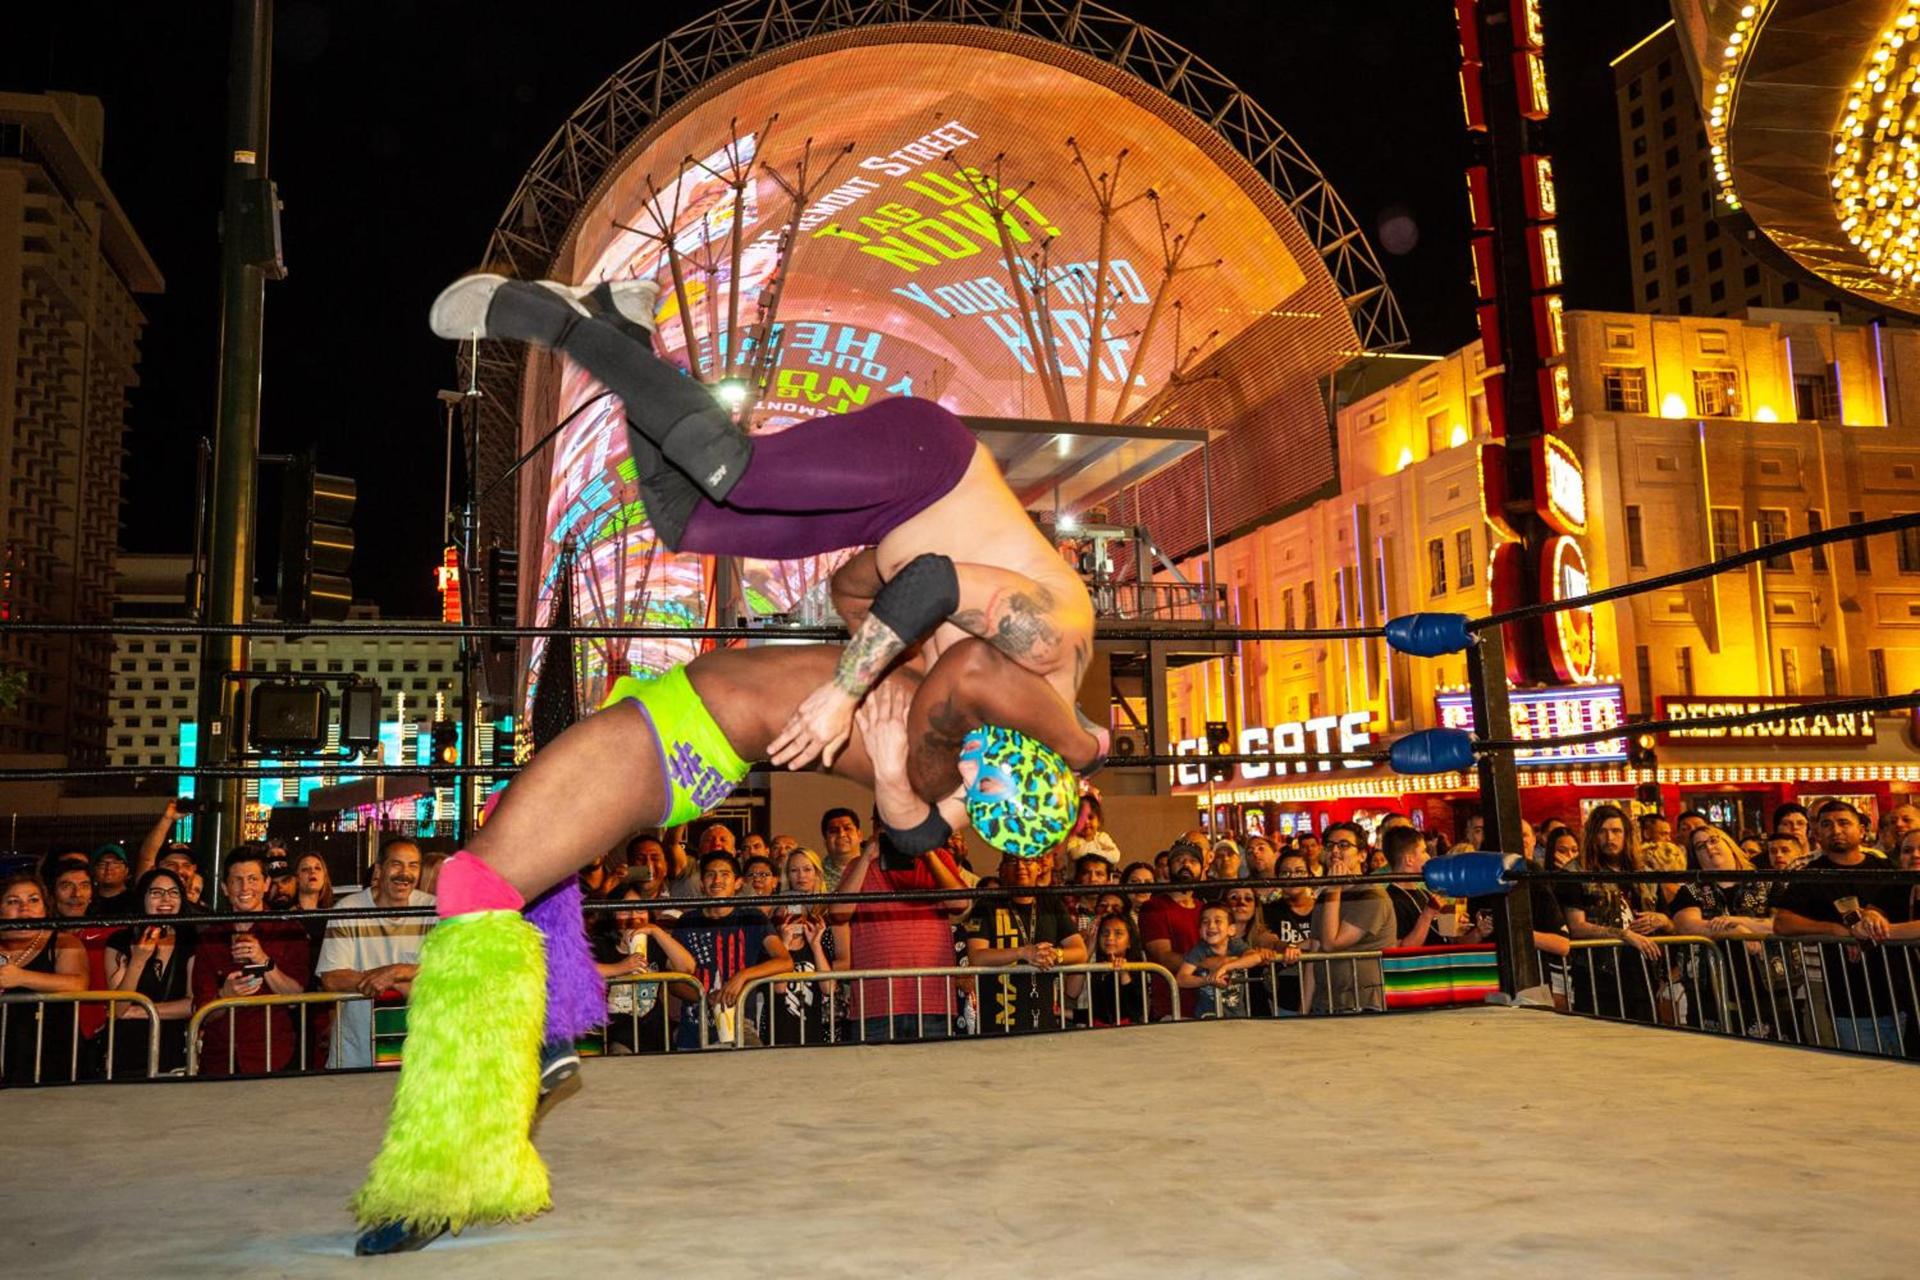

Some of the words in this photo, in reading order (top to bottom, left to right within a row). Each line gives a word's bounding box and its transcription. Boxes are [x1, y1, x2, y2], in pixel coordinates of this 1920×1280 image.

[858, 120, 980, 177] STREET
[812, 202, 922, 244] TAG
[903, 166, 999, 206] US
[860, 188, 1062, 273] NOW!
[892, 276, 1019, 319] YOUR
[1537, 158, 1573, 423] GATE
[808, 350, 914, 398] YOUR
[1239, 711, 1374, 779] GATE
[1666, 703, 1875, 738] RESTAURANT
